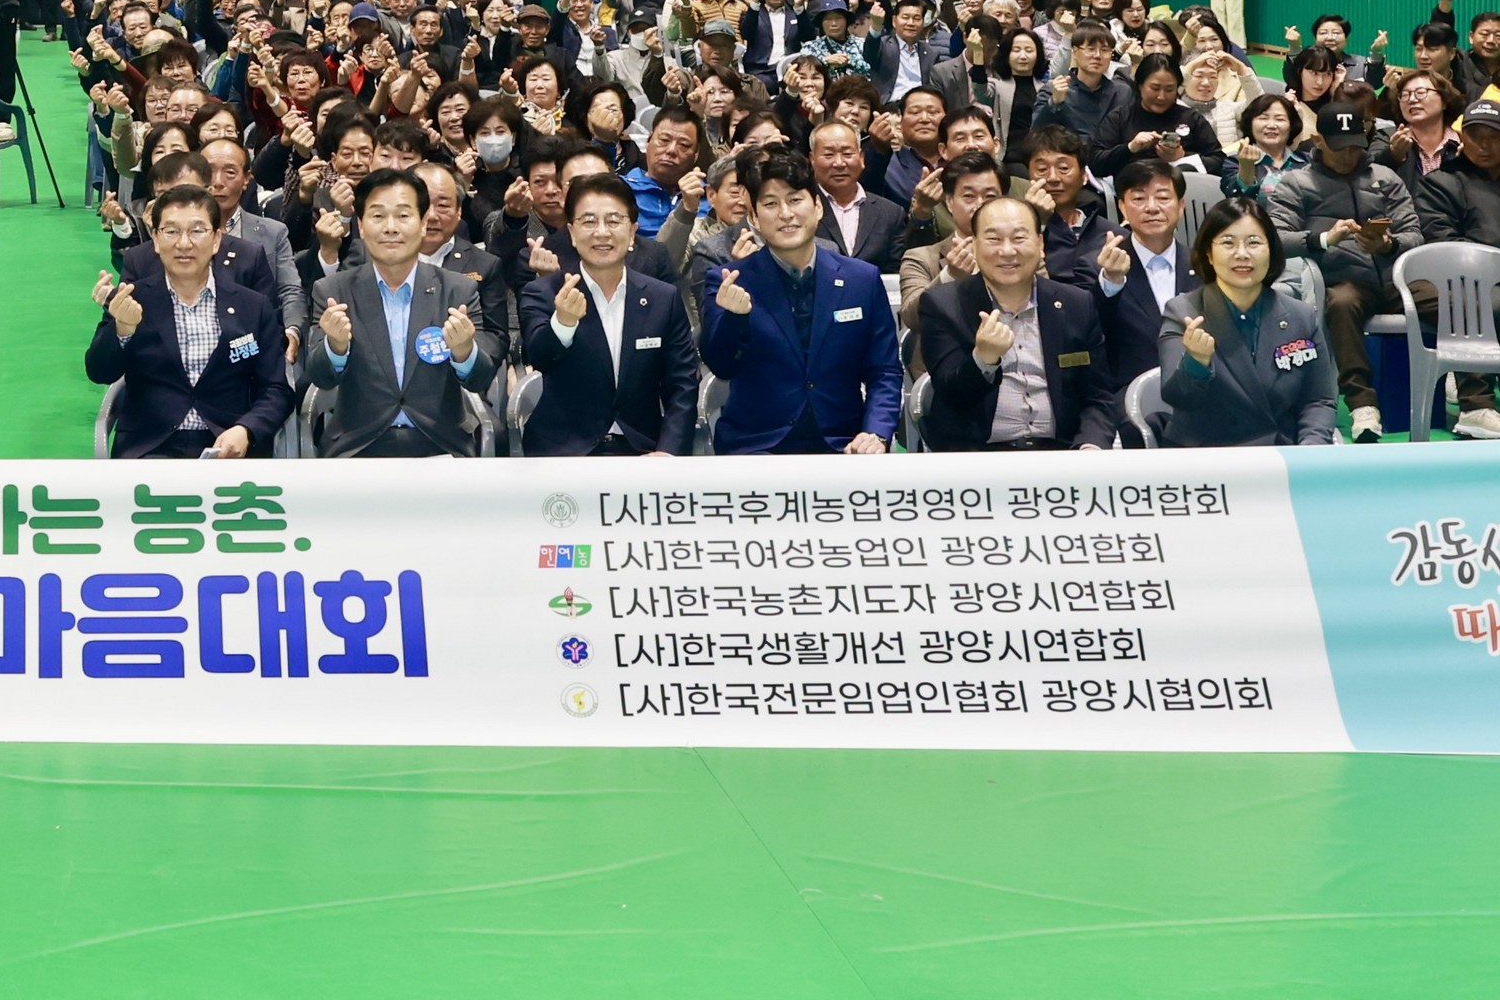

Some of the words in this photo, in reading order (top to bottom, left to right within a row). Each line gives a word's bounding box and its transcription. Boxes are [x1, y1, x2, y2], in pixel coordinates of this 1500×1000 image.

[1336, 113, 1353, 131] T
[1274, 348, 1318, 371] 박경미
[131, 482, 312, 555] 농촌.
[600, 488, 994, 526] [사]한국후계농업경영인
[1008, 484, 1230, 520] 광양시연합회
[604, 537, 928, 571] [사]한국여성농업인
[941, 533, 1165, 566] 광양시연합회
[609, 584, 937, 618] [사]한국농촌지도자
[949, 580, 1176, 614] 광양시연합회
[614, 632, 906, 667] [사]한국생활개선
[919, 628, 1147, 664] 광양시연합회
[619, 681, 1029, 717] [사]한국전문임업인협회
[1042, 677, 1273, 712] 광양시협의회
